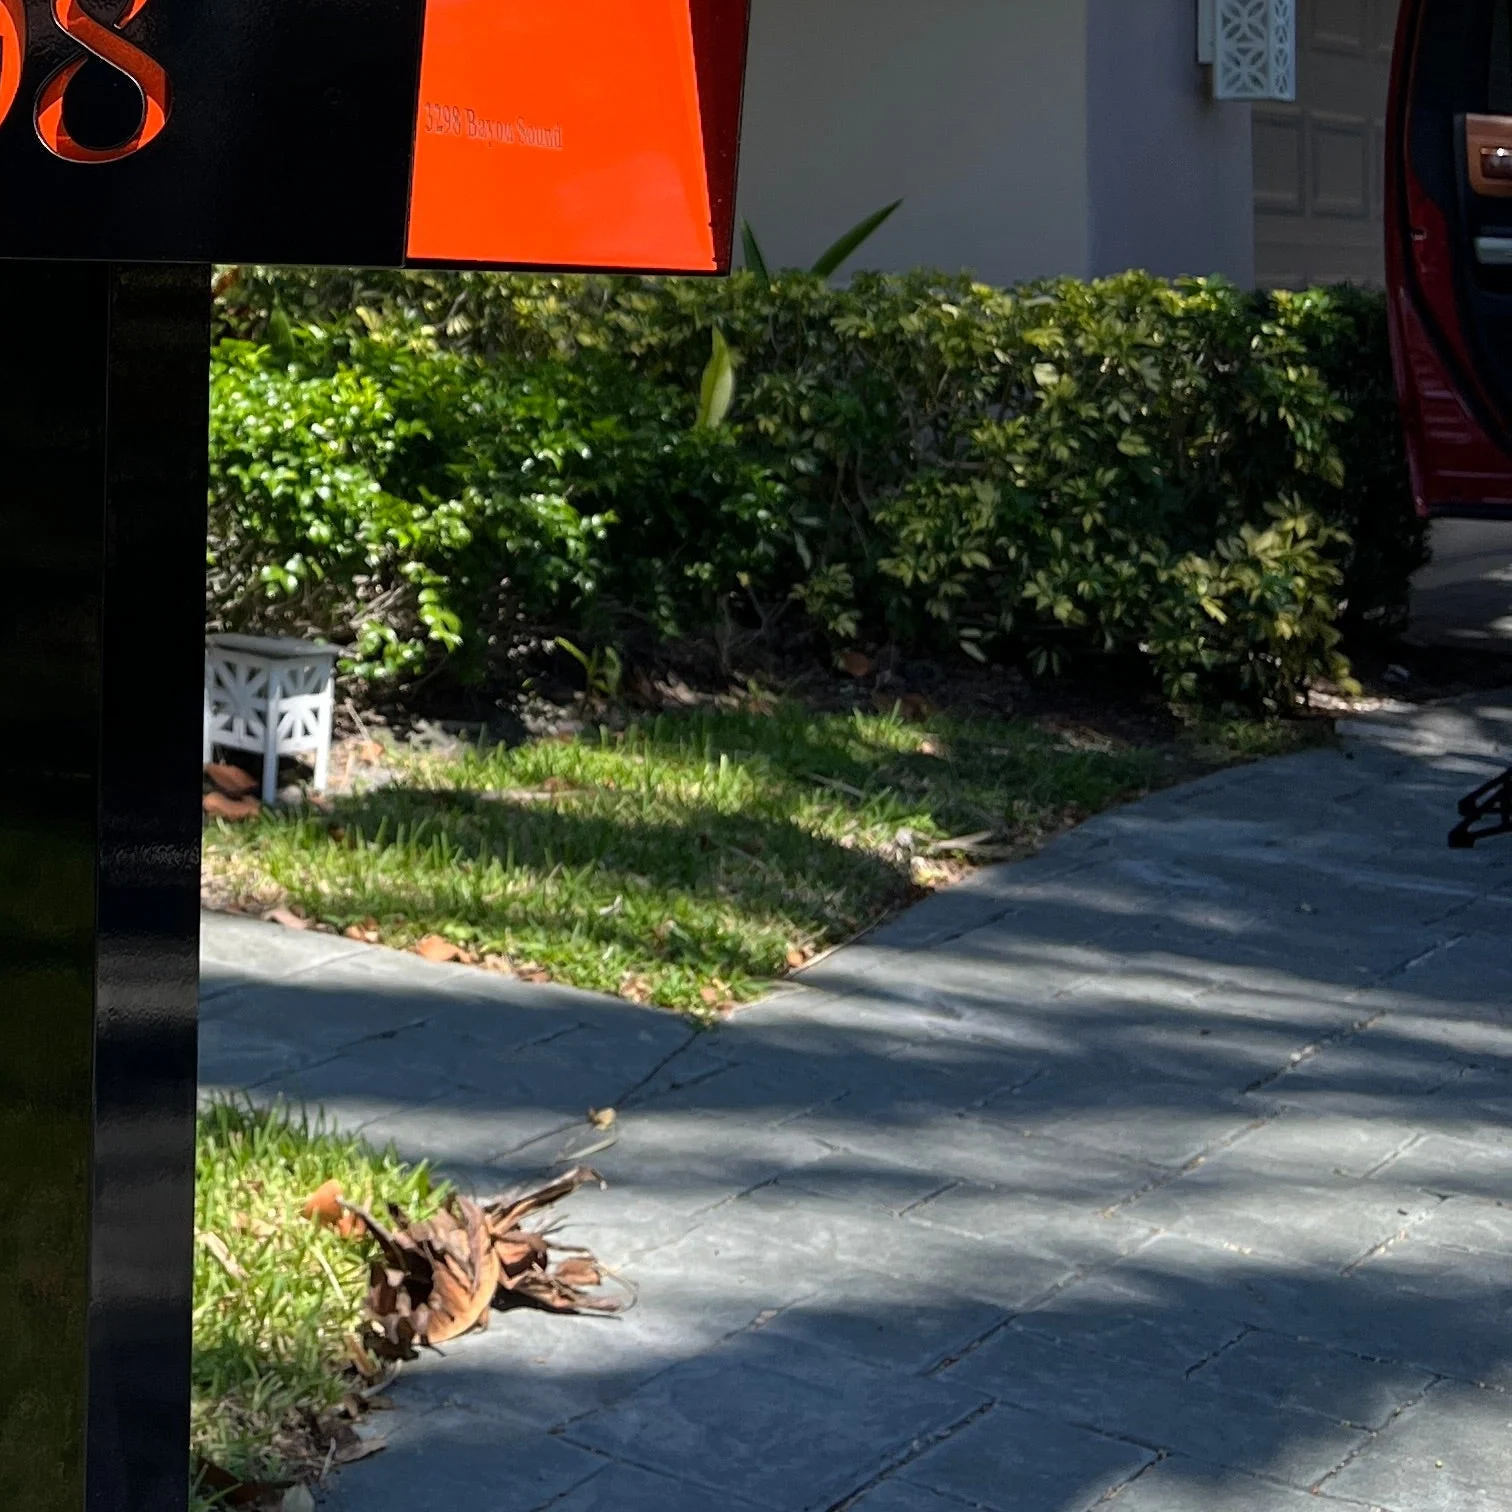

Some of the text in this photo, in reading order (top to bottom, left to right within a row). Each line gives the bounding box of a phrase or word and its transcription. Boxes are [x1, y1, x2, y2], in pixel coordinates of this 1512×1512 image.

[424, 101, 564, 150] 3298 Bayou Sound
